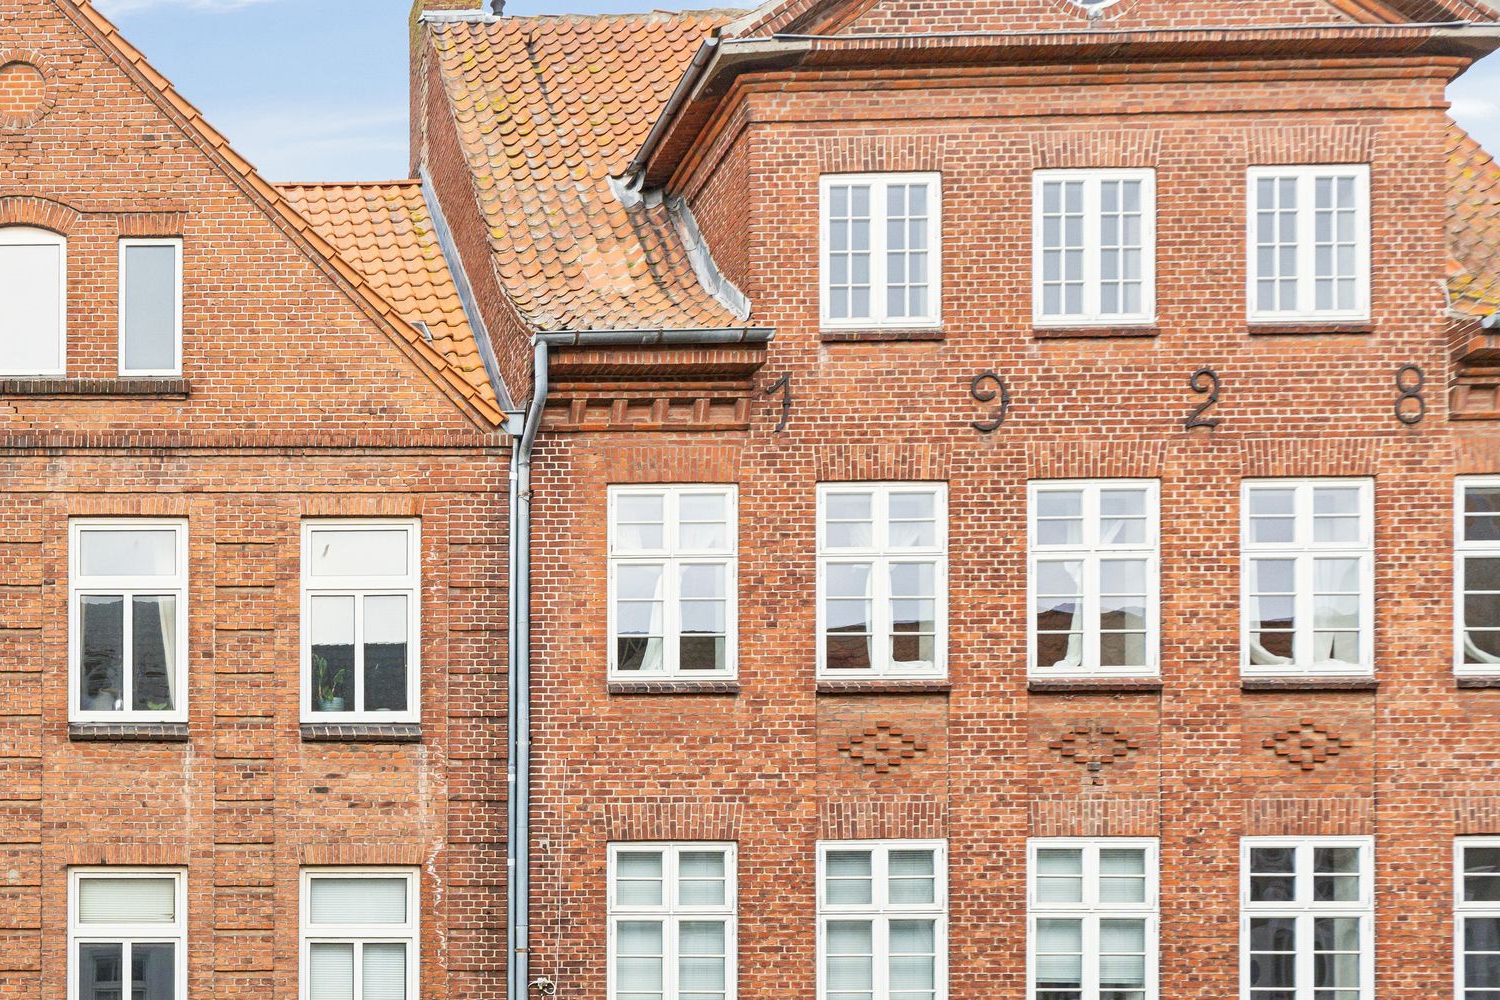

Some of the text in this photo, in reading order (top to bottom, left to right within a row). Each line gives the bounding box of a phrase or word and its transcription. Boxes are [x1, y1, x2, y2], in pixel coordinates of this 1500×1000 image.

[970, 369, 1010, 432] 9
[1185, 367, 1221, 430] 2
[1394, 363, 1426, 424] 8
